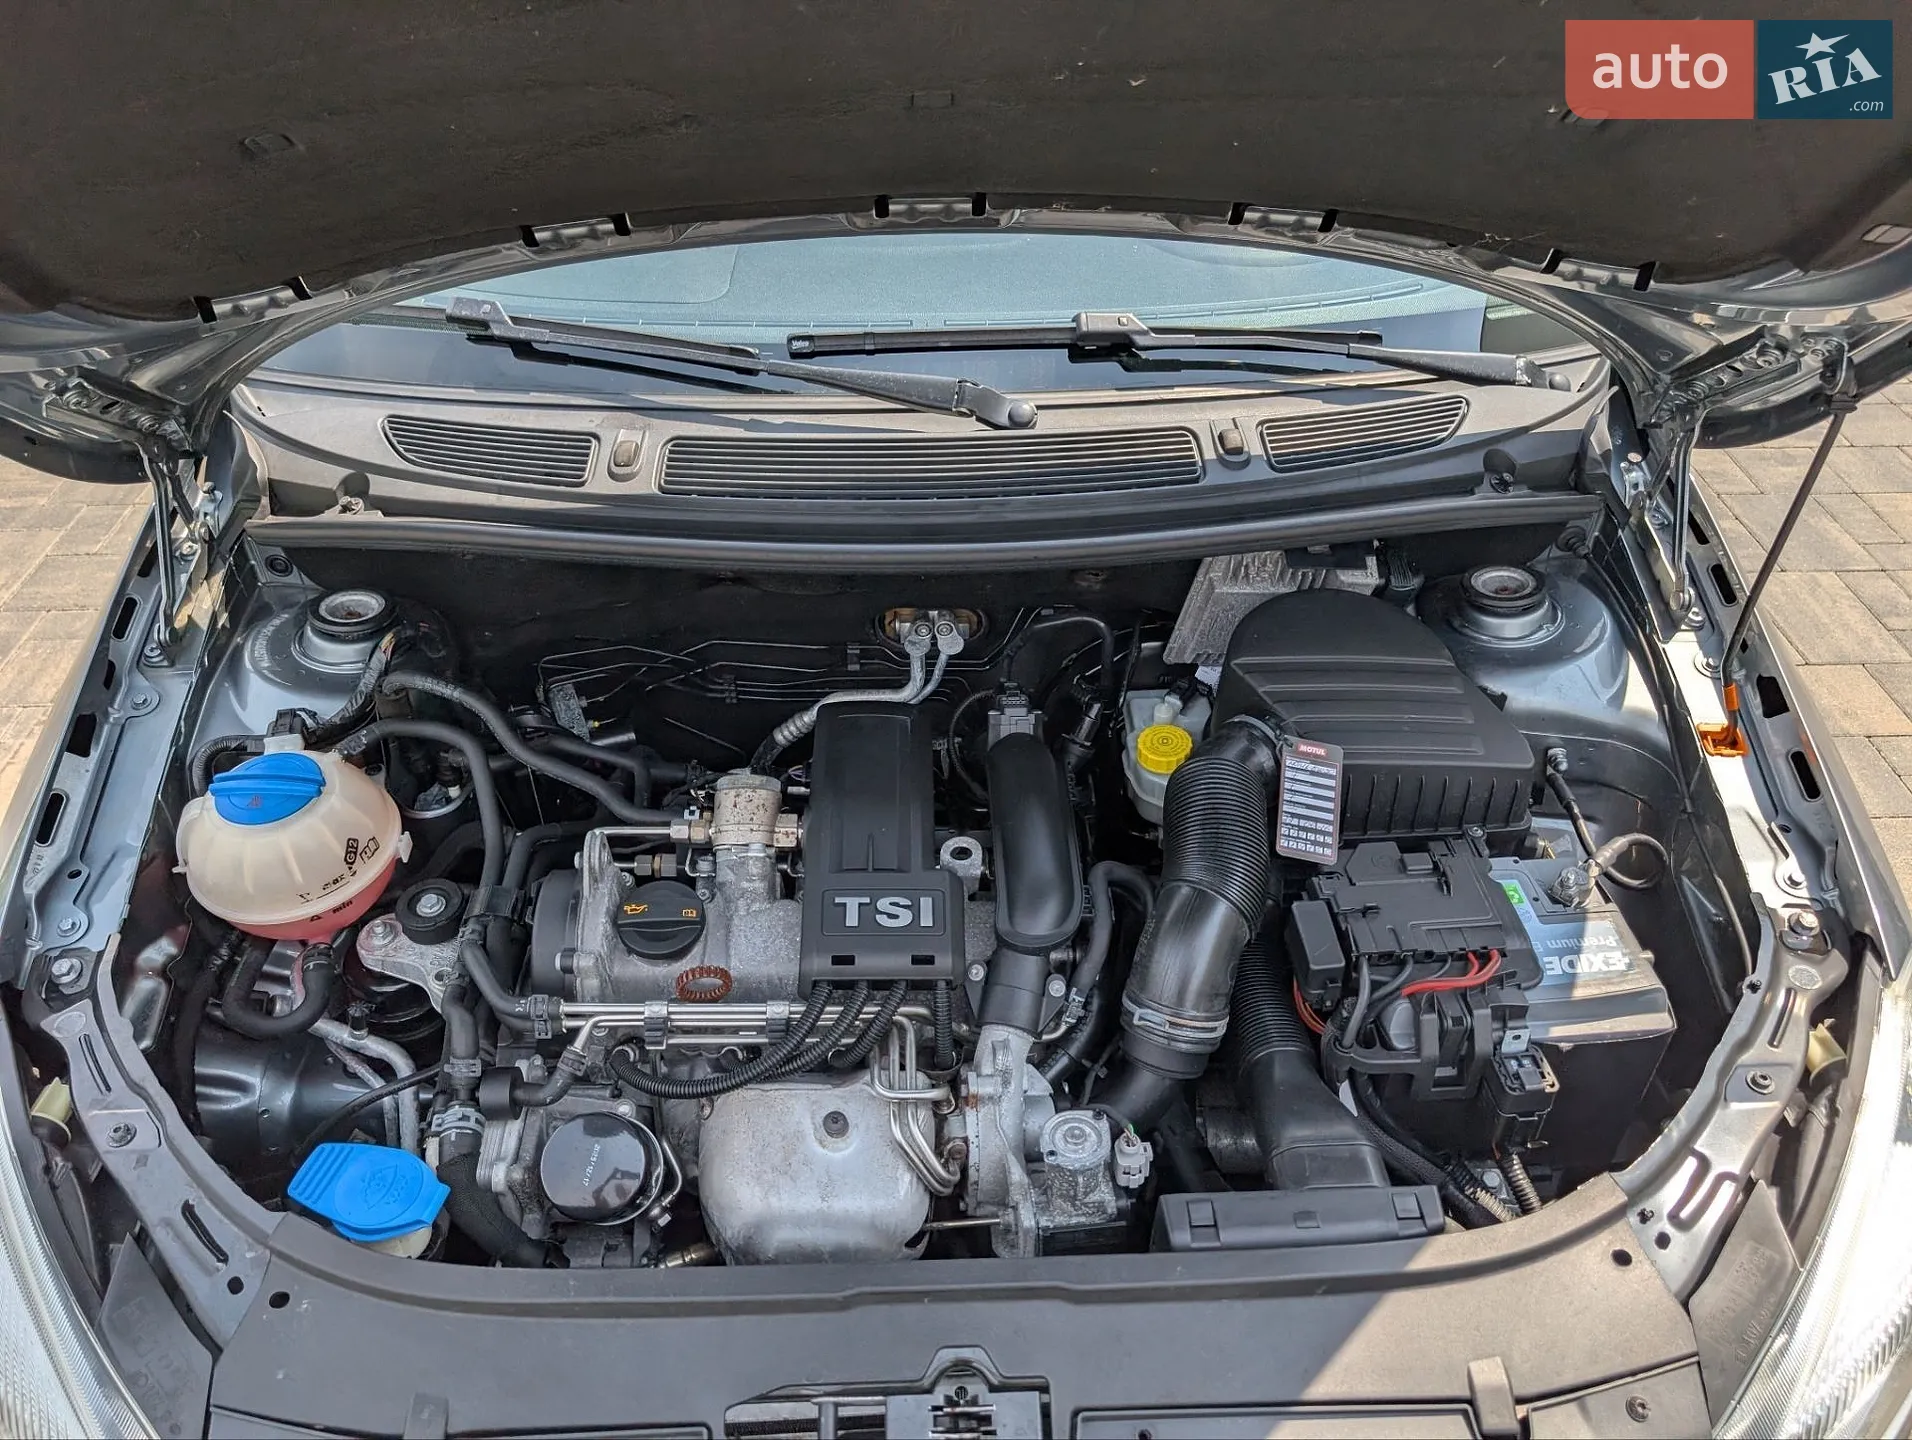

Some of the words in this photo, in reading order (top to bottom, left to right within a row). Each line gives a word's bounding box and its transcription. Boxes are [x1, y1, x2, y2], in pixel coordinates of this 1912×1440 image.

[1299, 744, 1326, 756] MOTUL
[347, 839, 358, 862] G12
[332, 901, 353, 914] min
[834, 896, 933, 928] TSI
[1546, 935, 1617, 950] Premium
[1544, 951, 1629, 975] EXIDE
